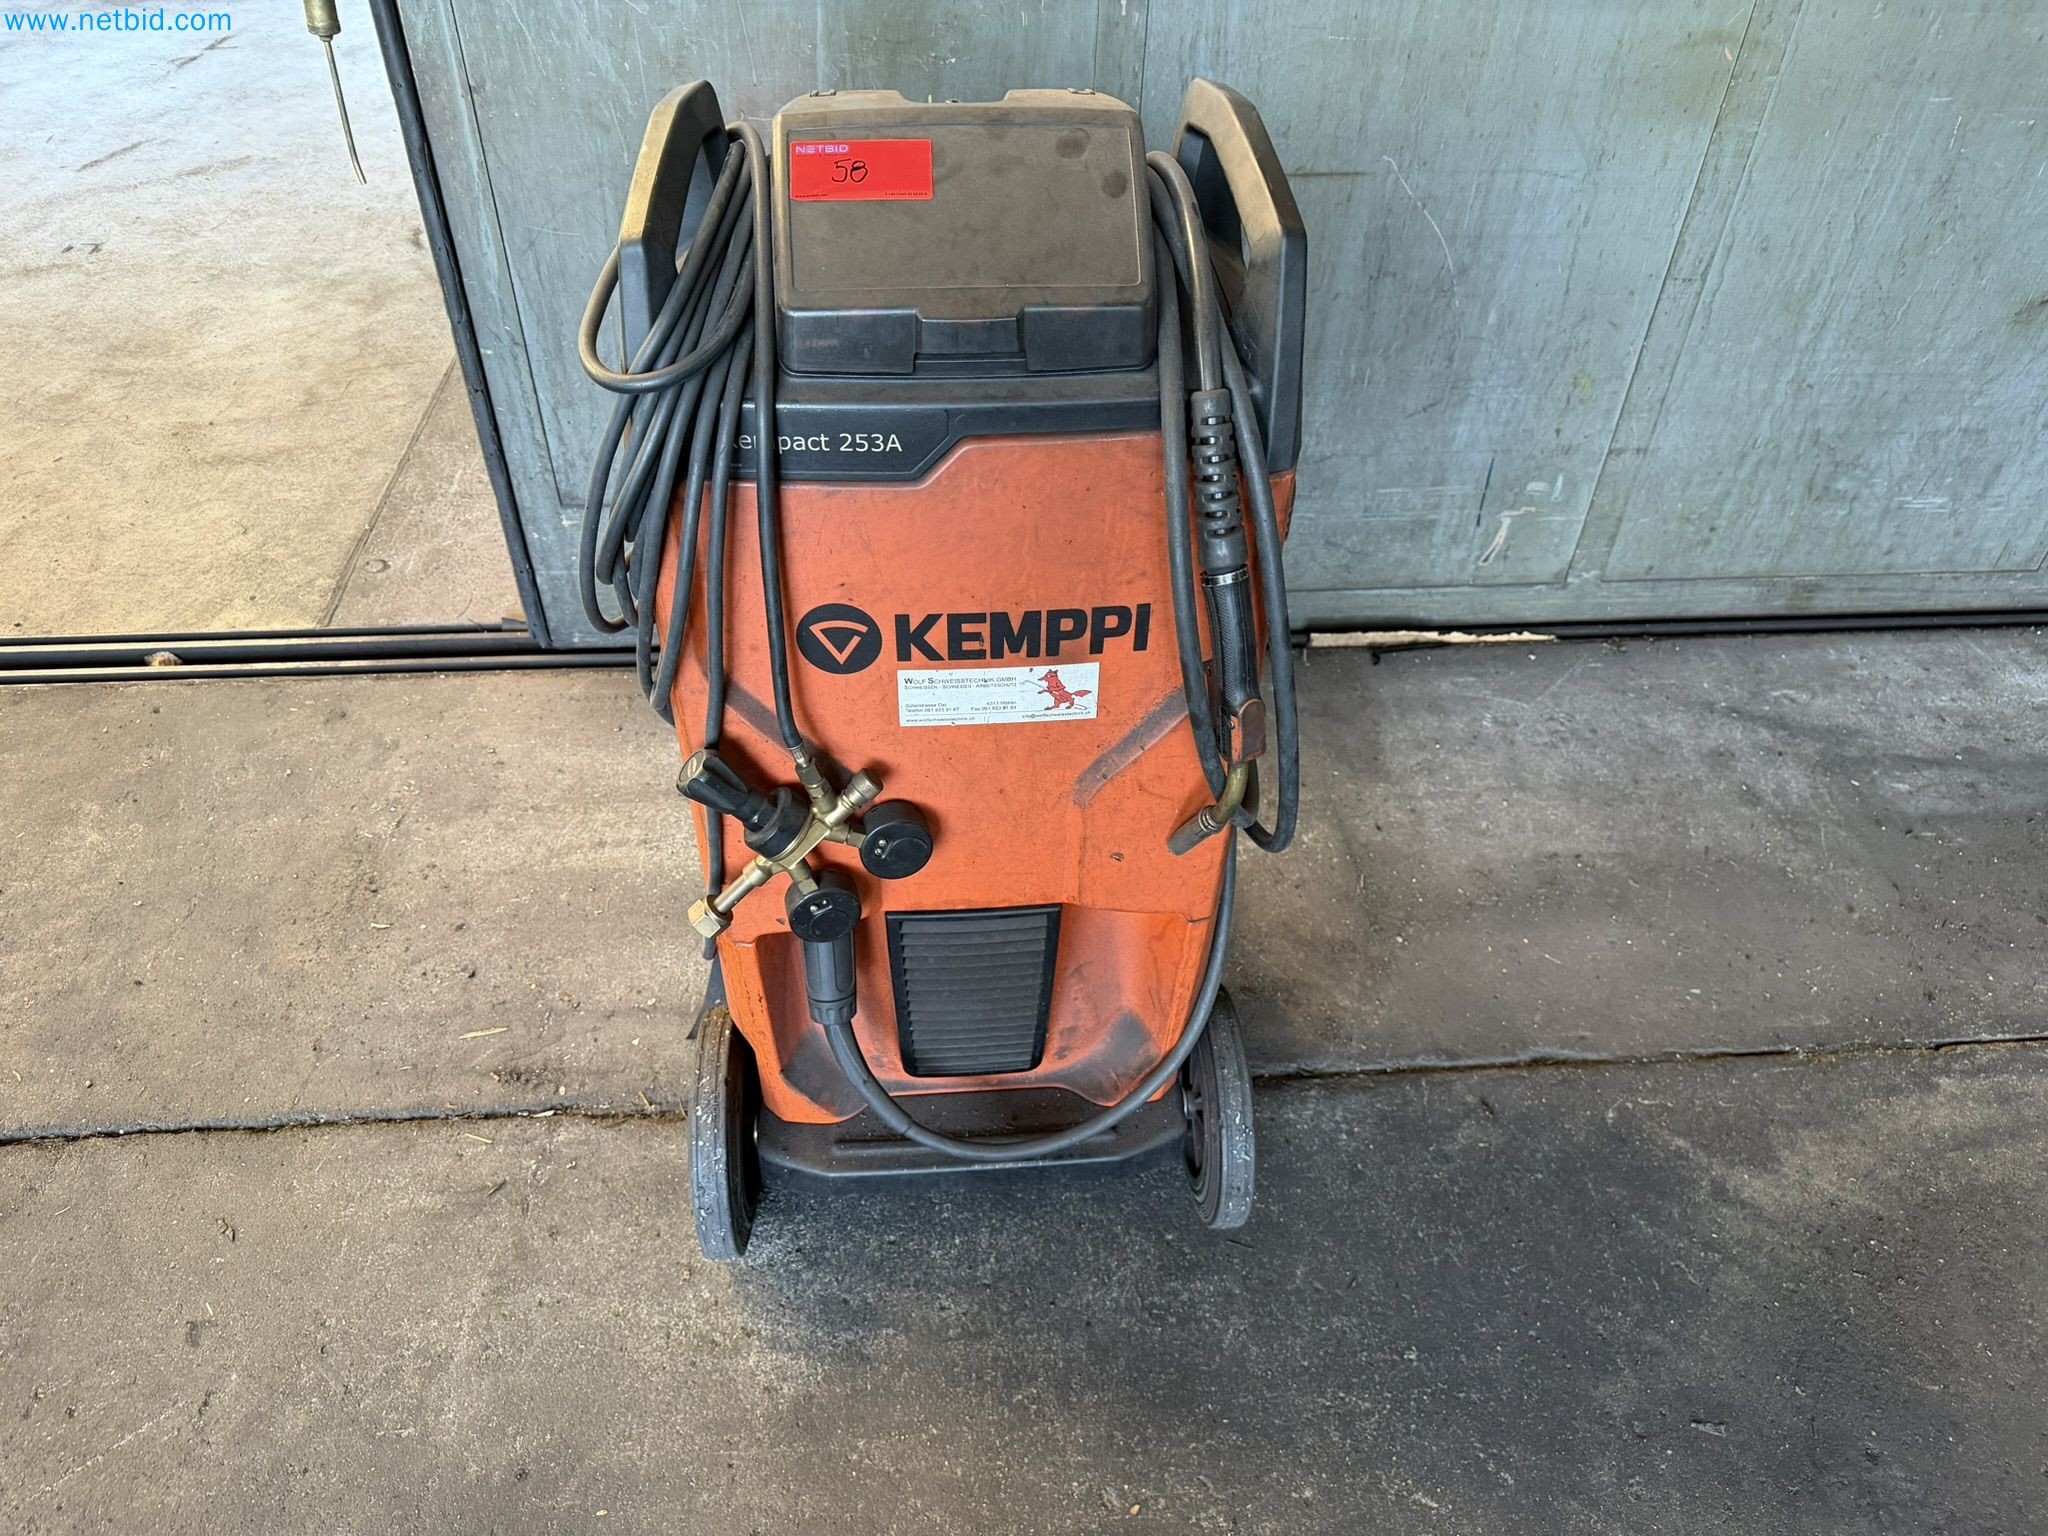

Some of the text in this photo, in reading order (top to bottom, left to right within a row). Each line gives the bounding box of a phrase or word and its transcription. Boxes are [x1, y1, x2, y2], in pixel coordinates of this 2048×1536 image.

[795, 144, 849, 154] NETBID
[831, 158, 869, 183] 58
[733, 433, 902, 454] epact 253A
[895, 603, 1151, 662] KEMPPI
[904, 677, 927, 685] WOLF
